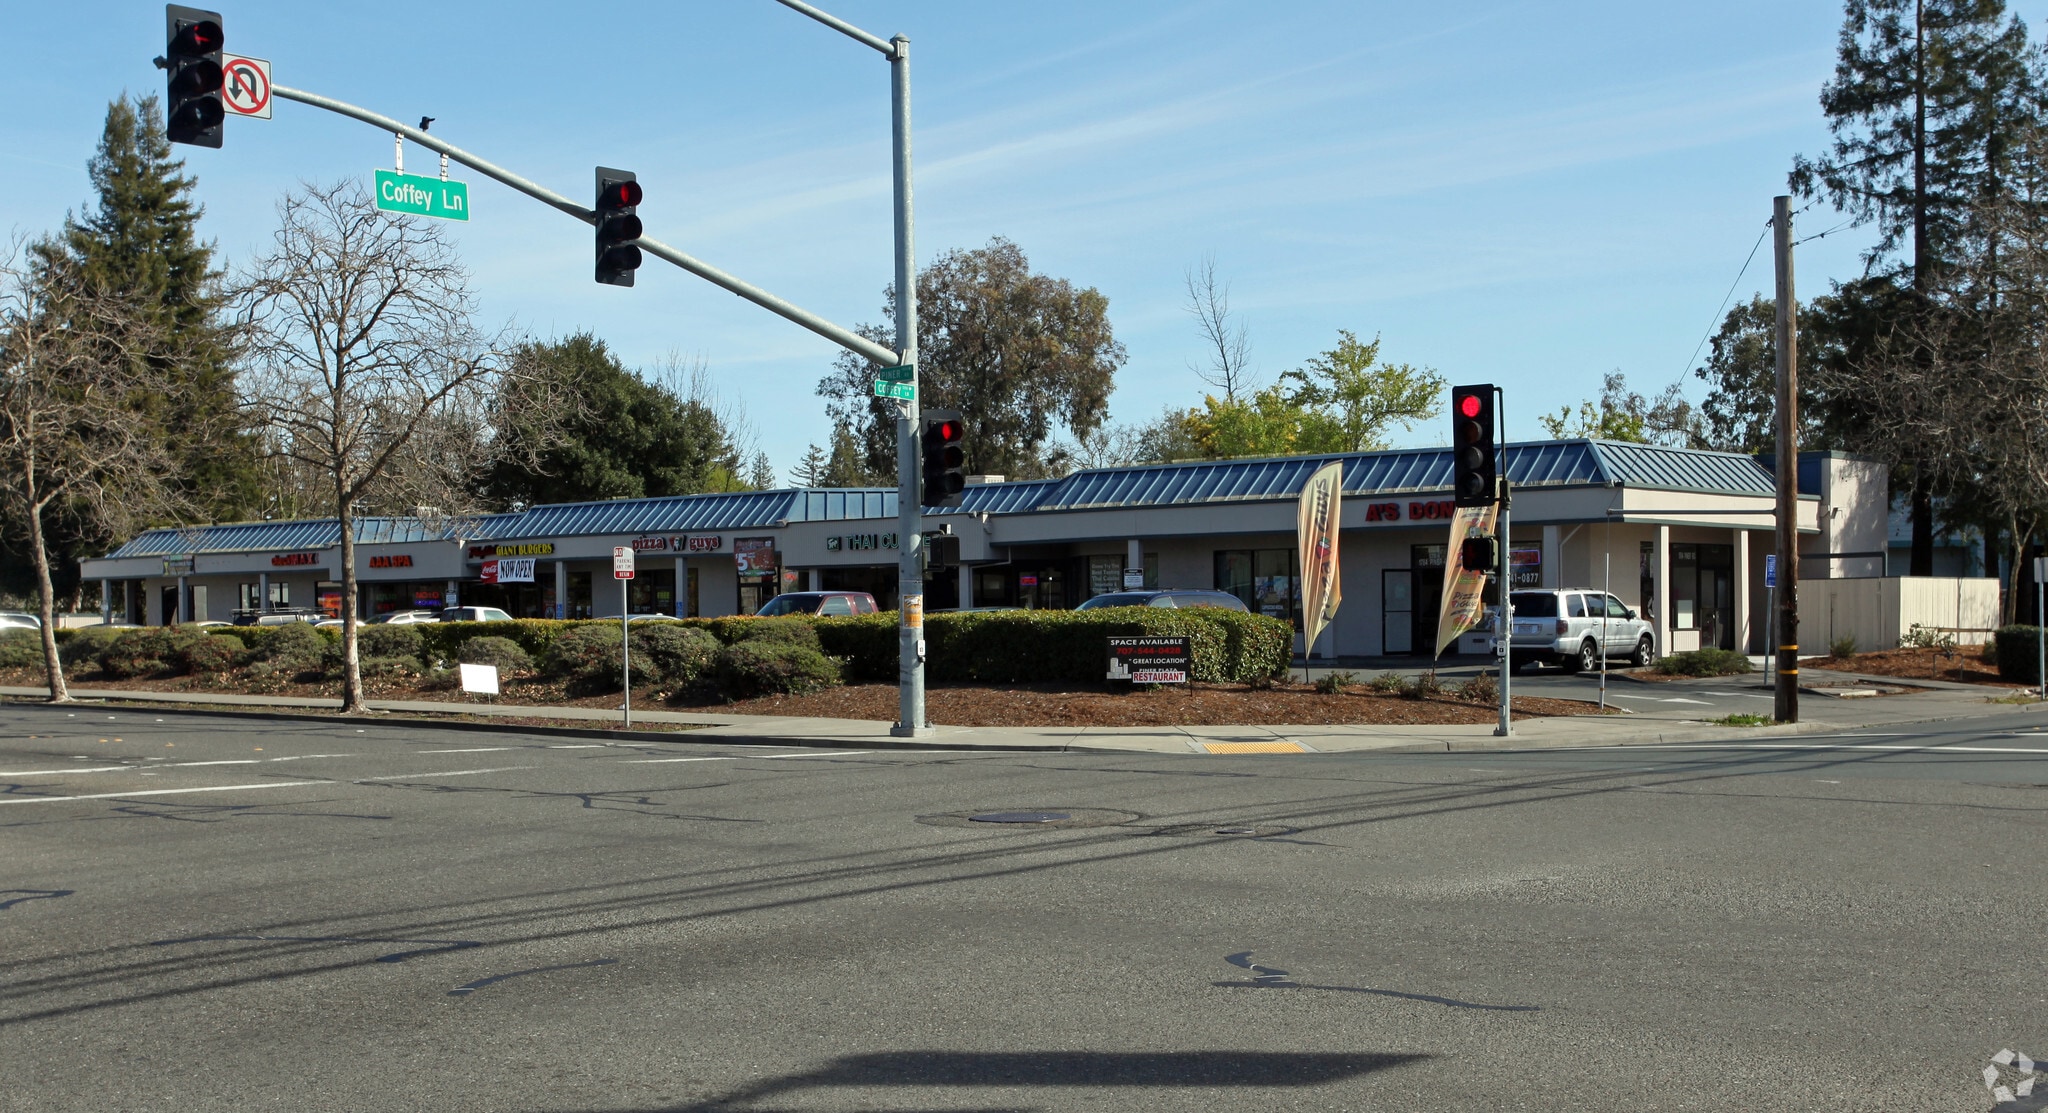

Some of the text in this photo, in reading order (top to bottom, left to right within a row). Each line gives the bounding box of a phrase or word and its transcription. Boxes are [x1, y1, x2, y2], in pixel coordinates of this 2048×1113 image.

[382, 180, 463, 211] Coffey Ln
[878, 384, 902, 396] COFFEY
[1365, 503, 1399, 522] A'S
[631, 535, 664, 551] pizza
[689, 536, 720, 551] guys
[845, 534, 876, 550] THAI
[496, 545, 517, 557] GIANT
[518, 543, 552, 556] BURGERS
[369, 555, 412, 568] AAA SPA
[500, 560, 534, 578] NOW OPEN
[1453, 591, 1479, 600] Pizza
[1133, 673, 1184, 681] RESTAURANT
